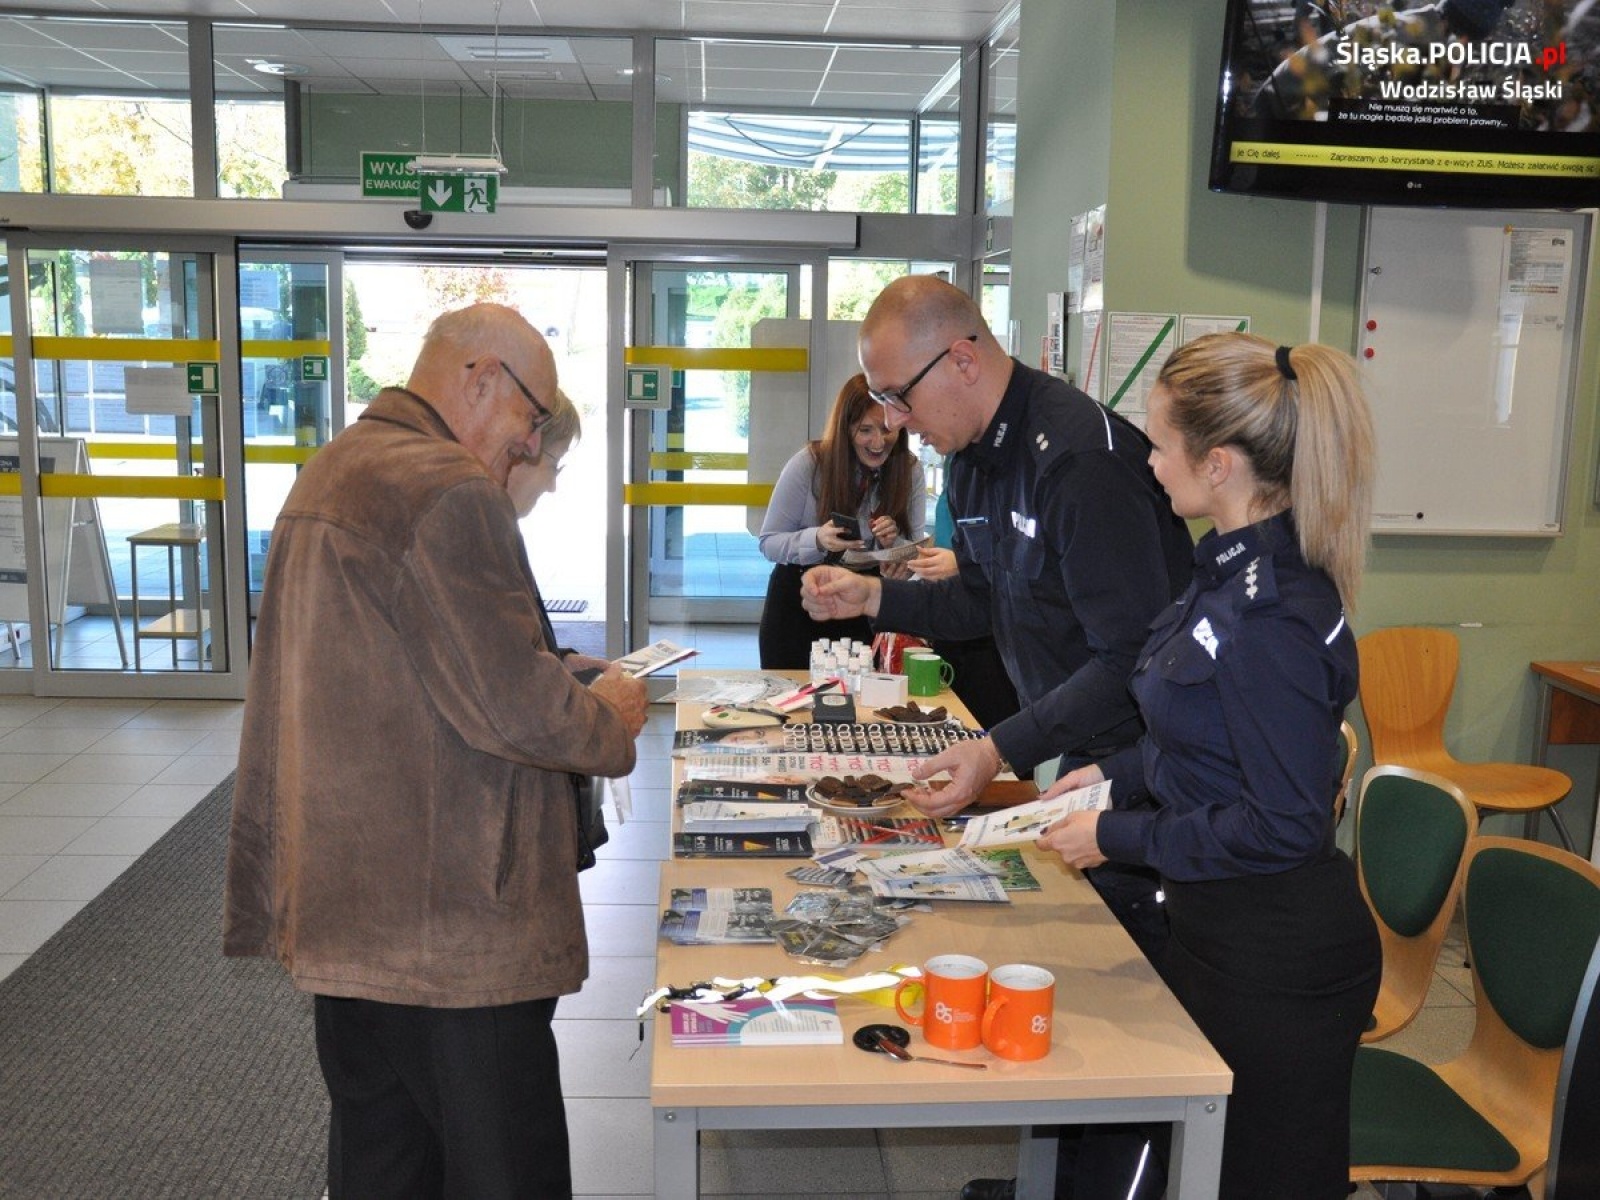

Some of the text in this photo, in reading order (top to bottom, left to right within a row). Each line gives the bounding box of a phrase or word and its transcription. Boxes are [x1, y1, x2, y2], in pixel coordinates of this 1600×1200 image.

[1368, 103, 1382, 112] Nie
[1384, 105, 1410, 114] muszą
[1411, 104, 1423, 114] się
[1424, 105, 1458, 114] martwić
[1349, 112, 1358, 121] tu
[1359, 113, 1383, 122] nagle
[1385, 113, 1413, 123] będzie
[1433, 115, 1469, 125] problem
[1330, 152, 1376, 164] Zapraszamy
[1379, 155, 1389, 163] do
[370, 156, 416, 175] WYJŚ
[365, 179, 421, 190] EWAKUAC
[1215, 542, 1247, 566] POLICJA
